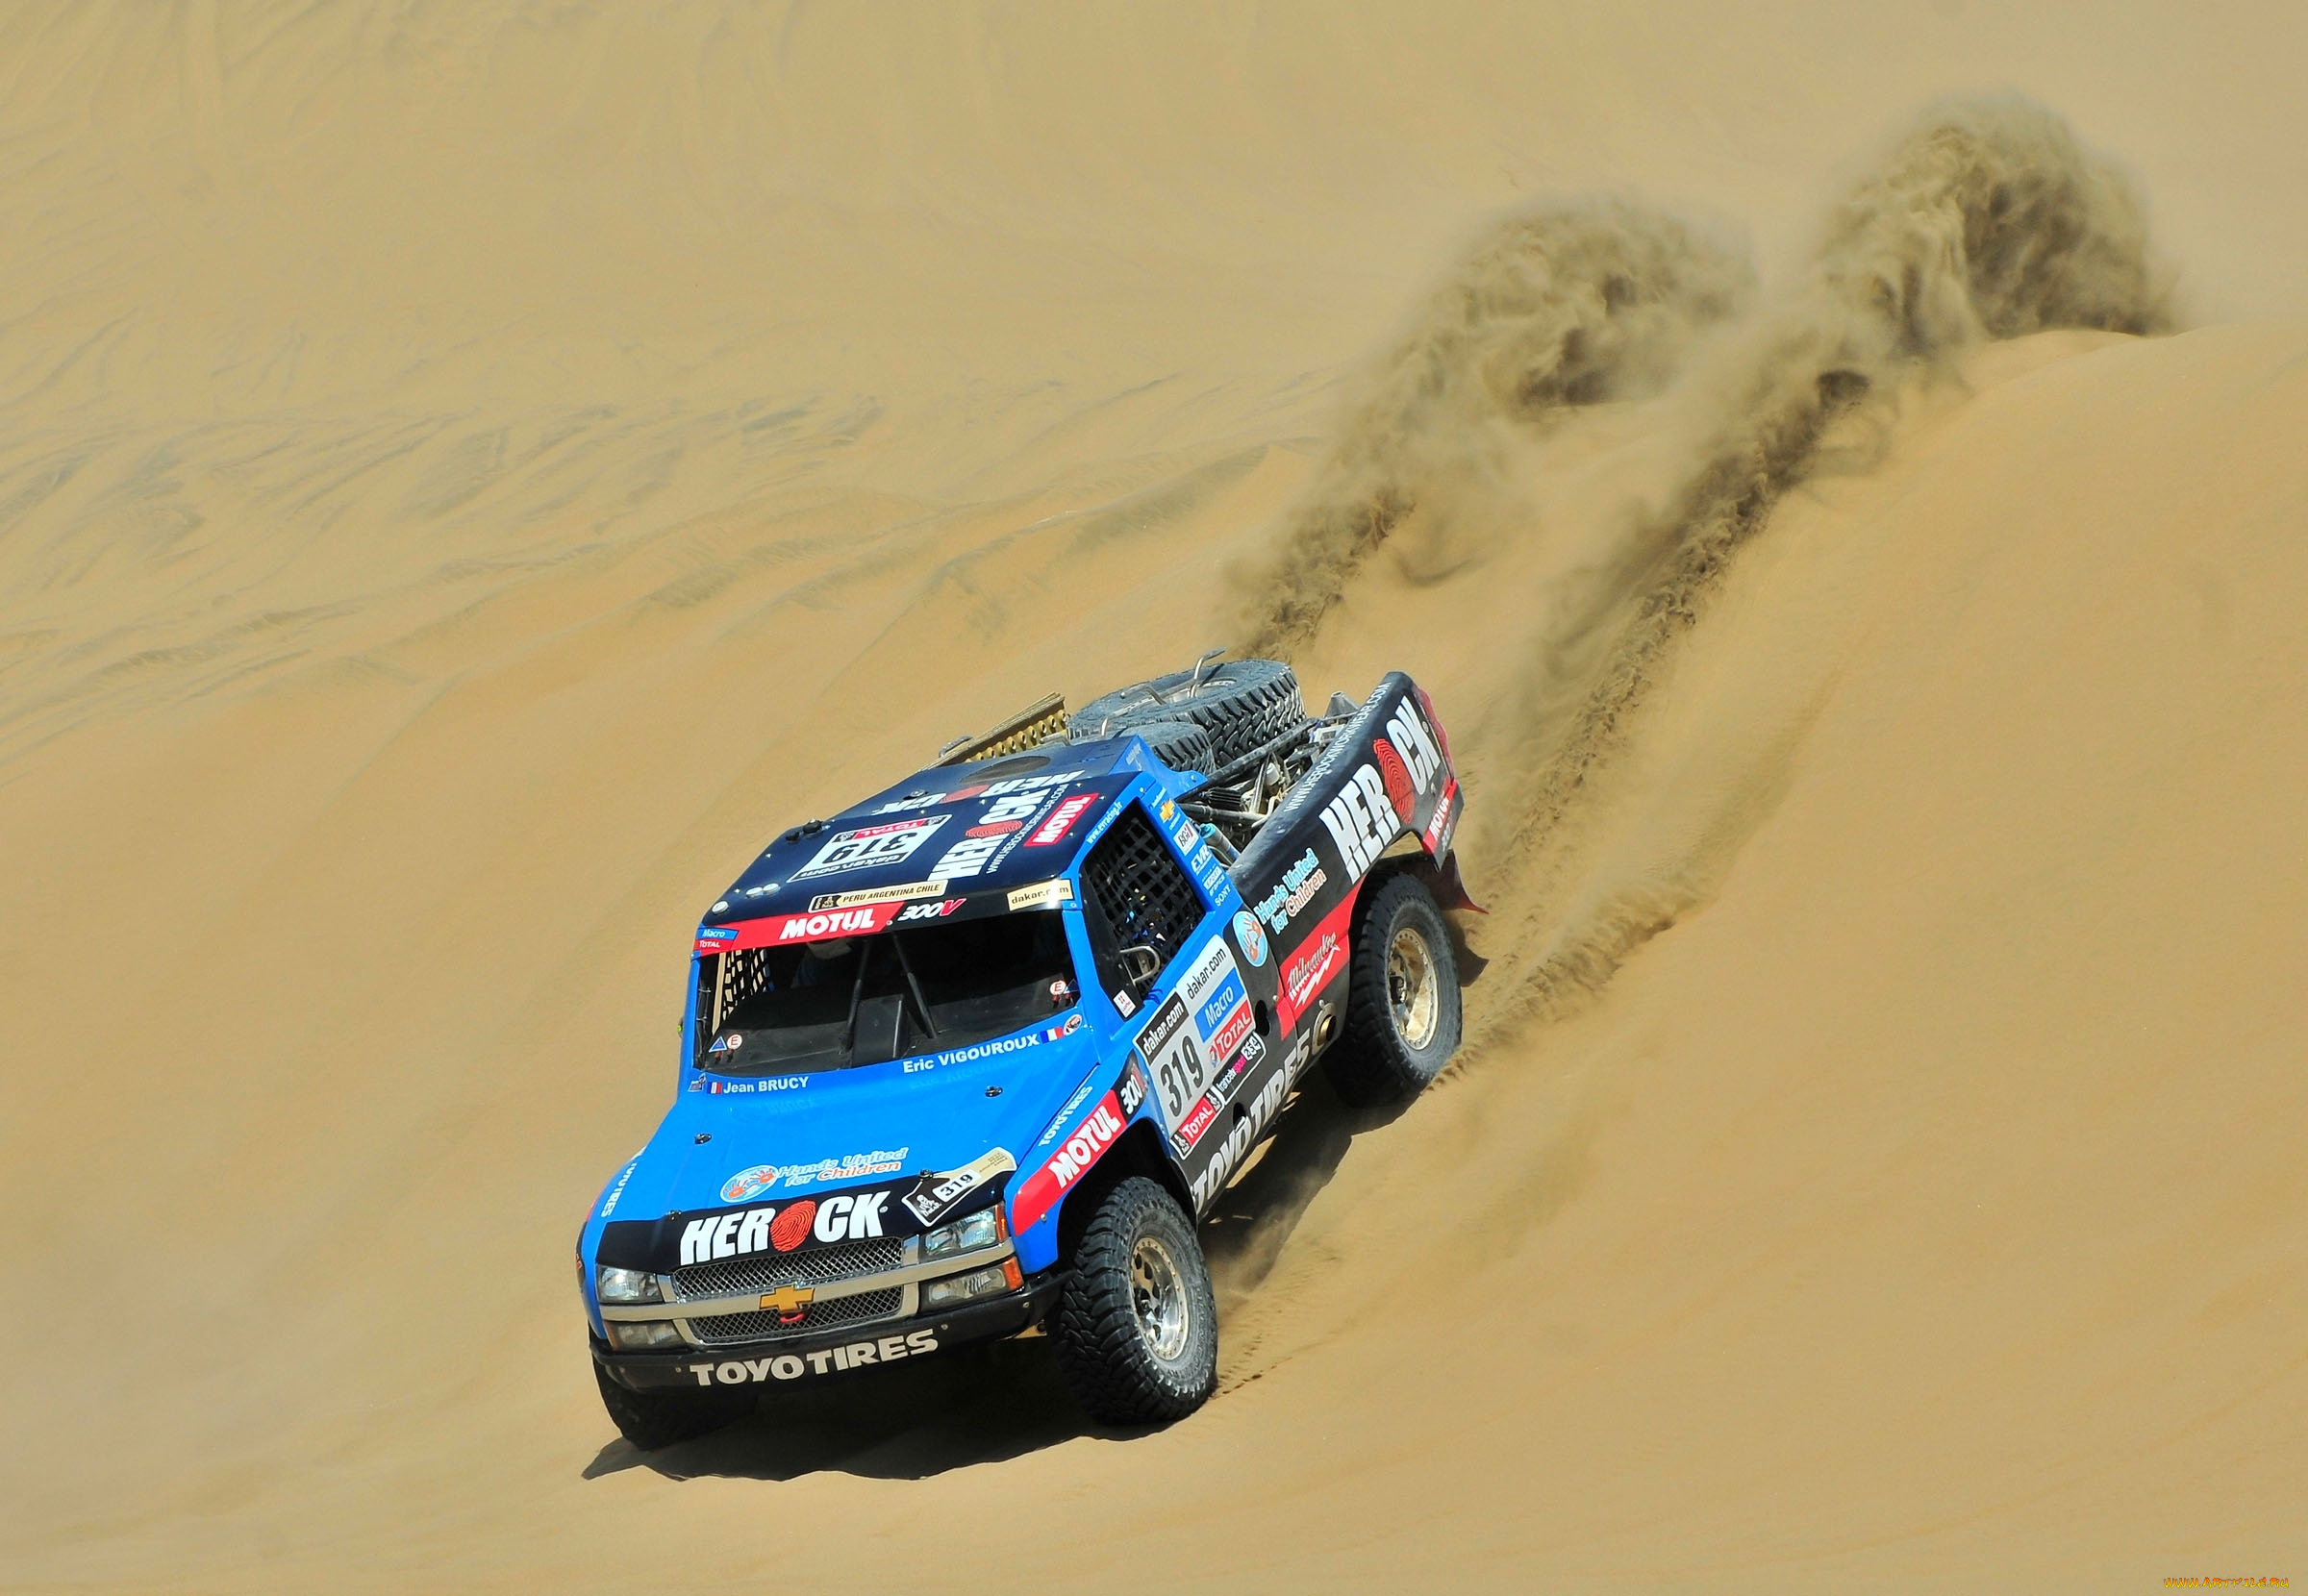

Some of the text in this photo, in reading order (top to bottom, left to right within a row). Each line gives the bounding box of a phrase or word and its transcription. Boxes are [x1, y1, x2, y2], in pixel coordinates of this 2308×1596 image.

[860, 821, 920, 836] TOTAL
[1033, 796, 1091, 844] MOTUL
[822, 833, 917, 863] 319
[842, 884, 941, 903] PERU ARGENTINA CHILE
[1011, 885, 1069, 905] dakar.cm
[1215, 885, 1231, 907] SONY
[1253, 847, 1319, 925] Hands United
[1270, 868, 1327, 935] for Children
[702, 929, 725, 938] Macro
[779, 898, 966, 940] MOTUL 300V
[1187, 948, 1227, 1000] dakar.com
[1287, 933, 1337, 993] Milwaukee
[1205, 985, 1234, 1028] Macro
[1142, 1001, 1185, 1057] dakar.com
[1217, 1010, 1251, 1053] TOTAL
[903, 1034, 1040, 1073] Eric VIGOUROUX
[723, 1077, 810, 1094] Jean BRUCY
[1160, 1035, 1204, 1117] 319
[1182, 1107, 1214, 1139] TOTAL
[778, 1147, 909, 1178] Hands United
[1047, 1106, 1121, 1188] MOTUL
[785, 1160, 902, 1188] for Children
[940, 1173, 973, 1197] 319
